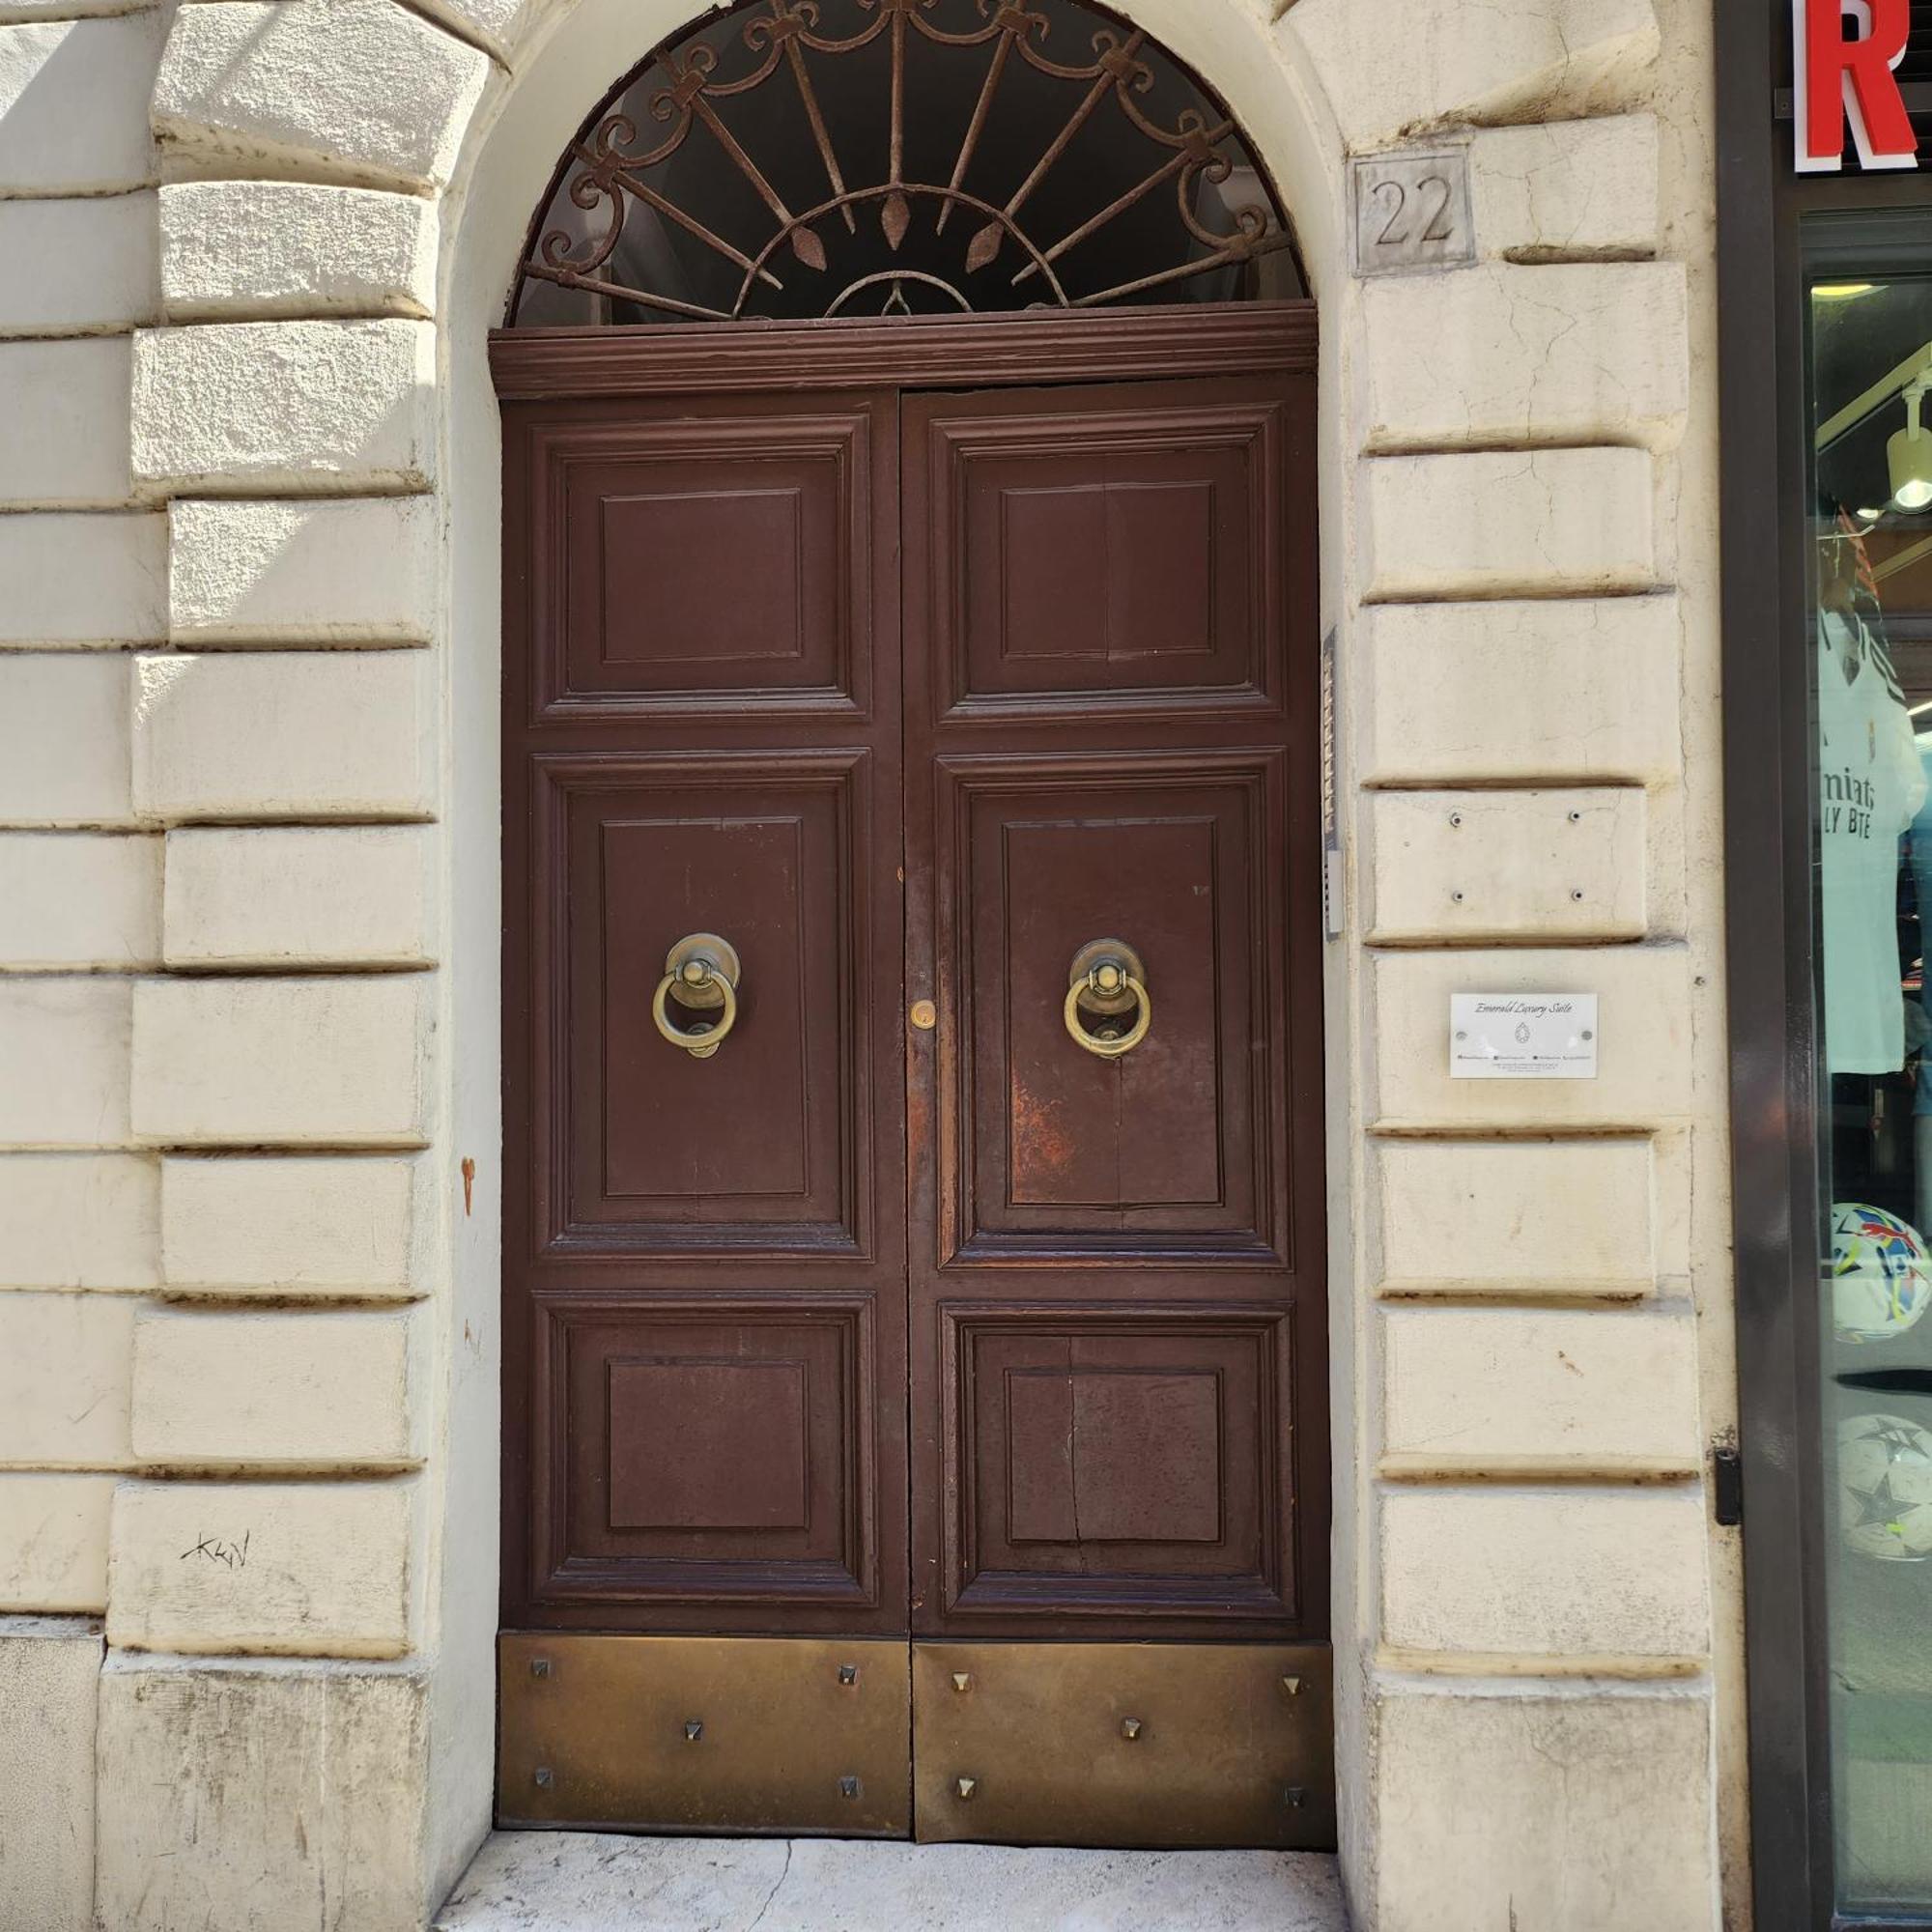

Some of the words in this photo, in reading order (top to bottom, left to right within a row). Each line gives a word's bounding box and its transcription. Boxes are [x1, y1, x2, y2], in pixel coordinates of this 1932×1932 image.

[1793, 0, 1918, 172] R
[1372, 176, 1455, 246] 22
[1475, 1002, 1515, 1013] Emerald
[1514, 1002, 1547, 1018] Luxury
[1548, 1002, 1573, 1013] Suite
